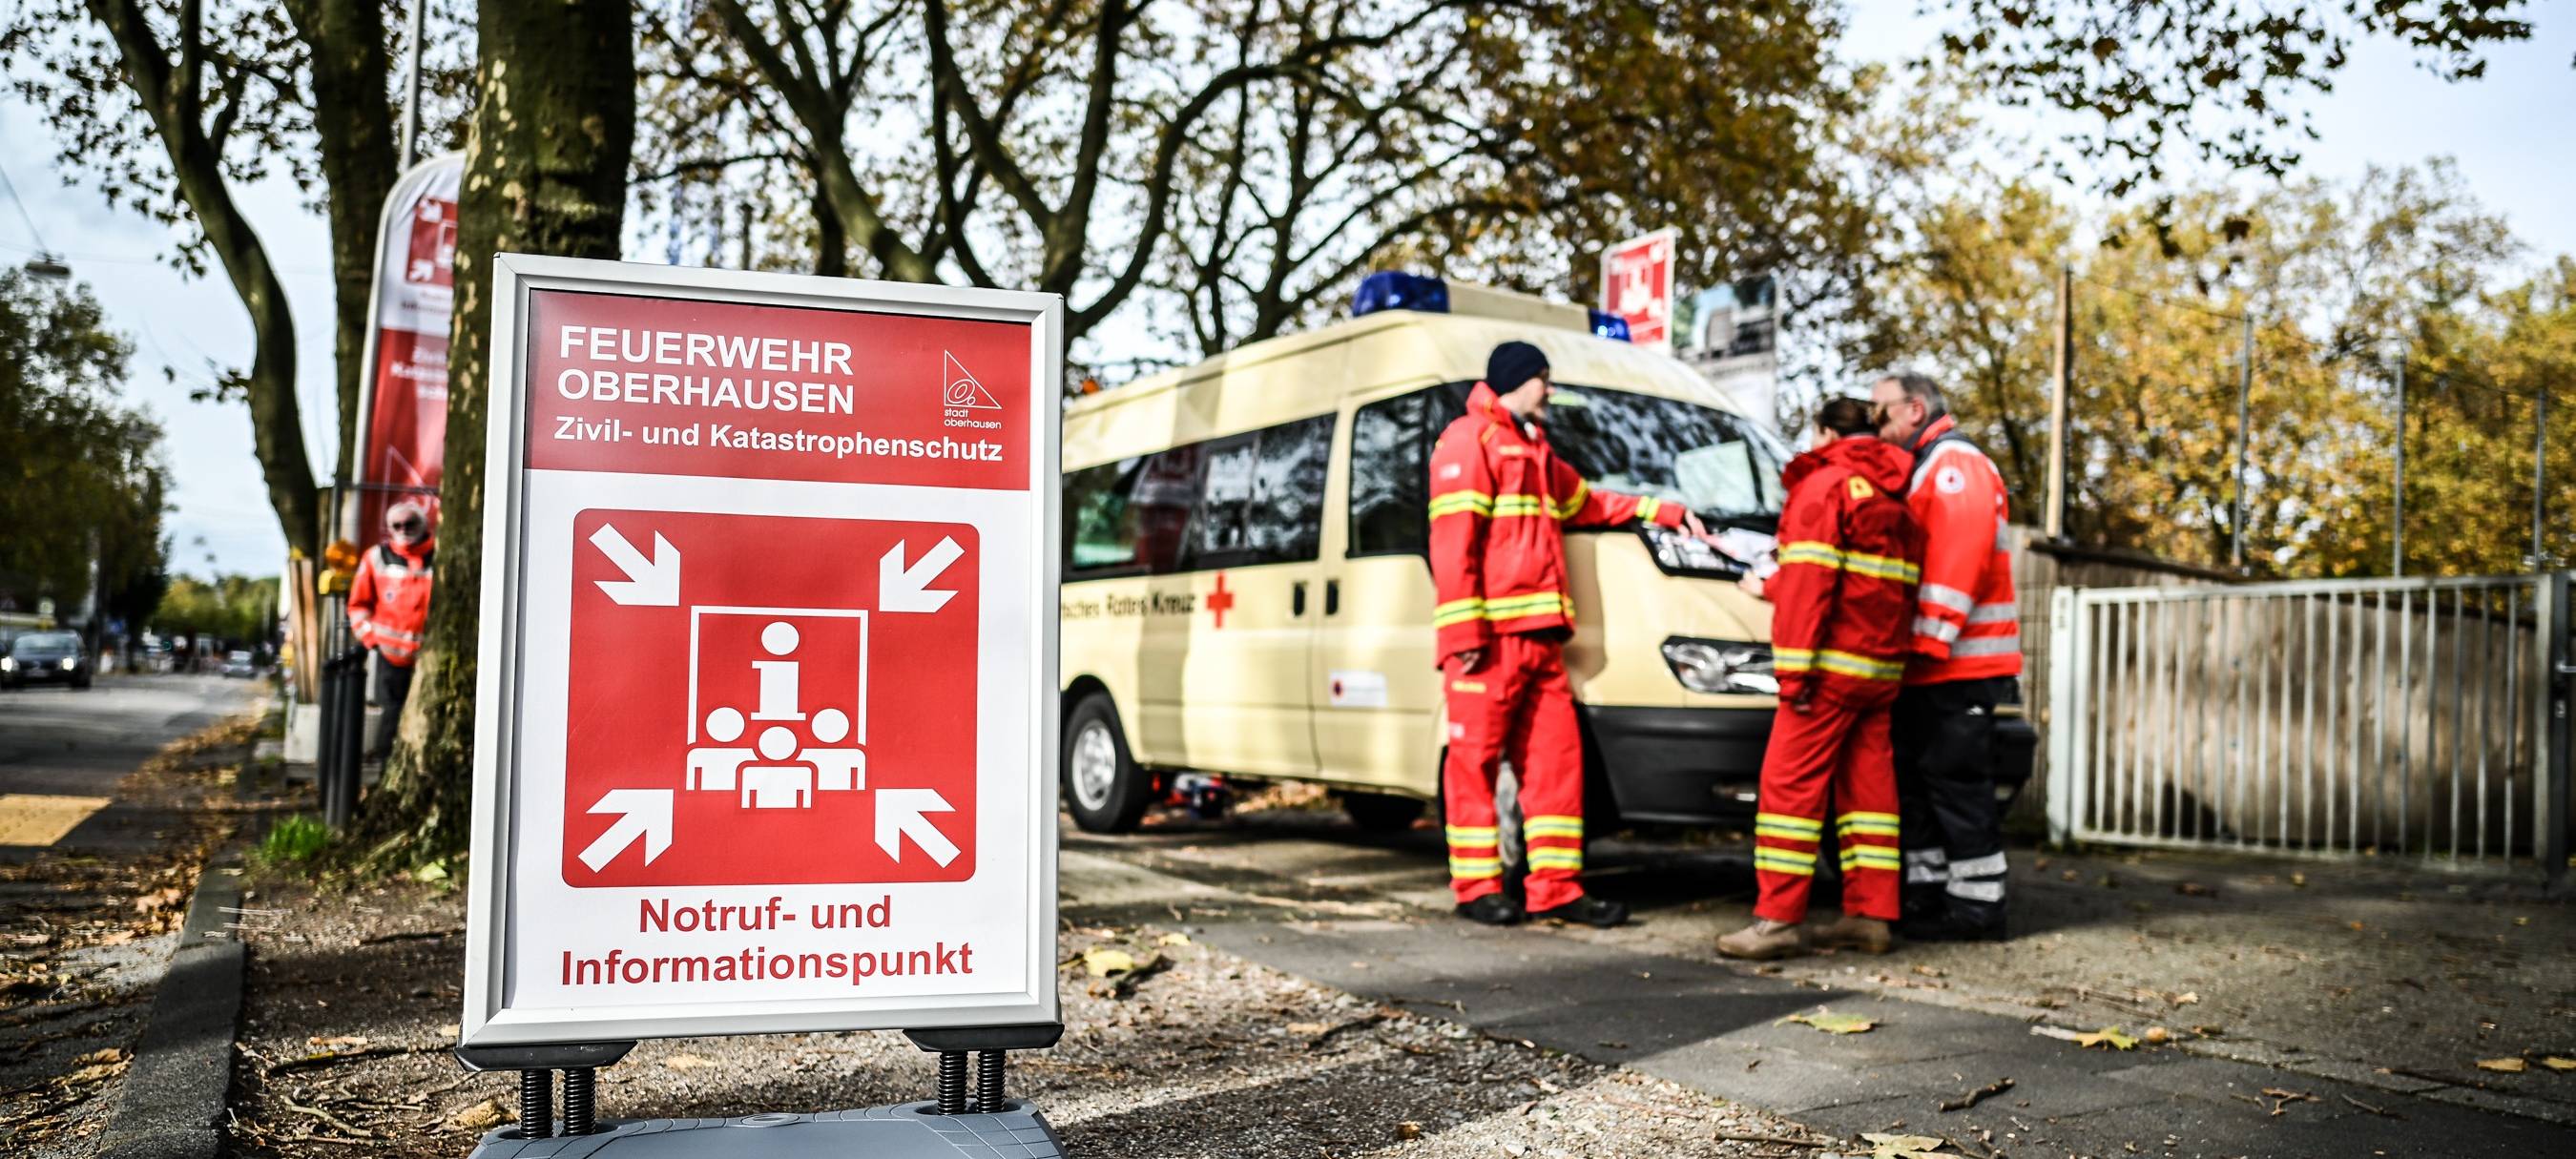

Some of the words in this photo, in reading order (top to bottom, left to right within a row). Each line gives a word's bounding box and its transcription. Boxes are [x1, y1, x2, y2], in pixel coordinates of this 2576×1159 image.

[559, 325, 853, 376] FEUERWEHR
[557, 368, 854, 415] OBERHAUSEN
[945, 408, 969, 418] stadt
[553, 416, 633, 444] Zivil-
[641, 423, 699, 446] und
[711, 424, 1003, 462] Katastrophenschutz
[944, 418, 1002, 429] oberhausen
[639, 897, 796, 933] Notruf-
[811, 895, 891, 929] und
[562, 942, 973, 986] Informationspunkt
